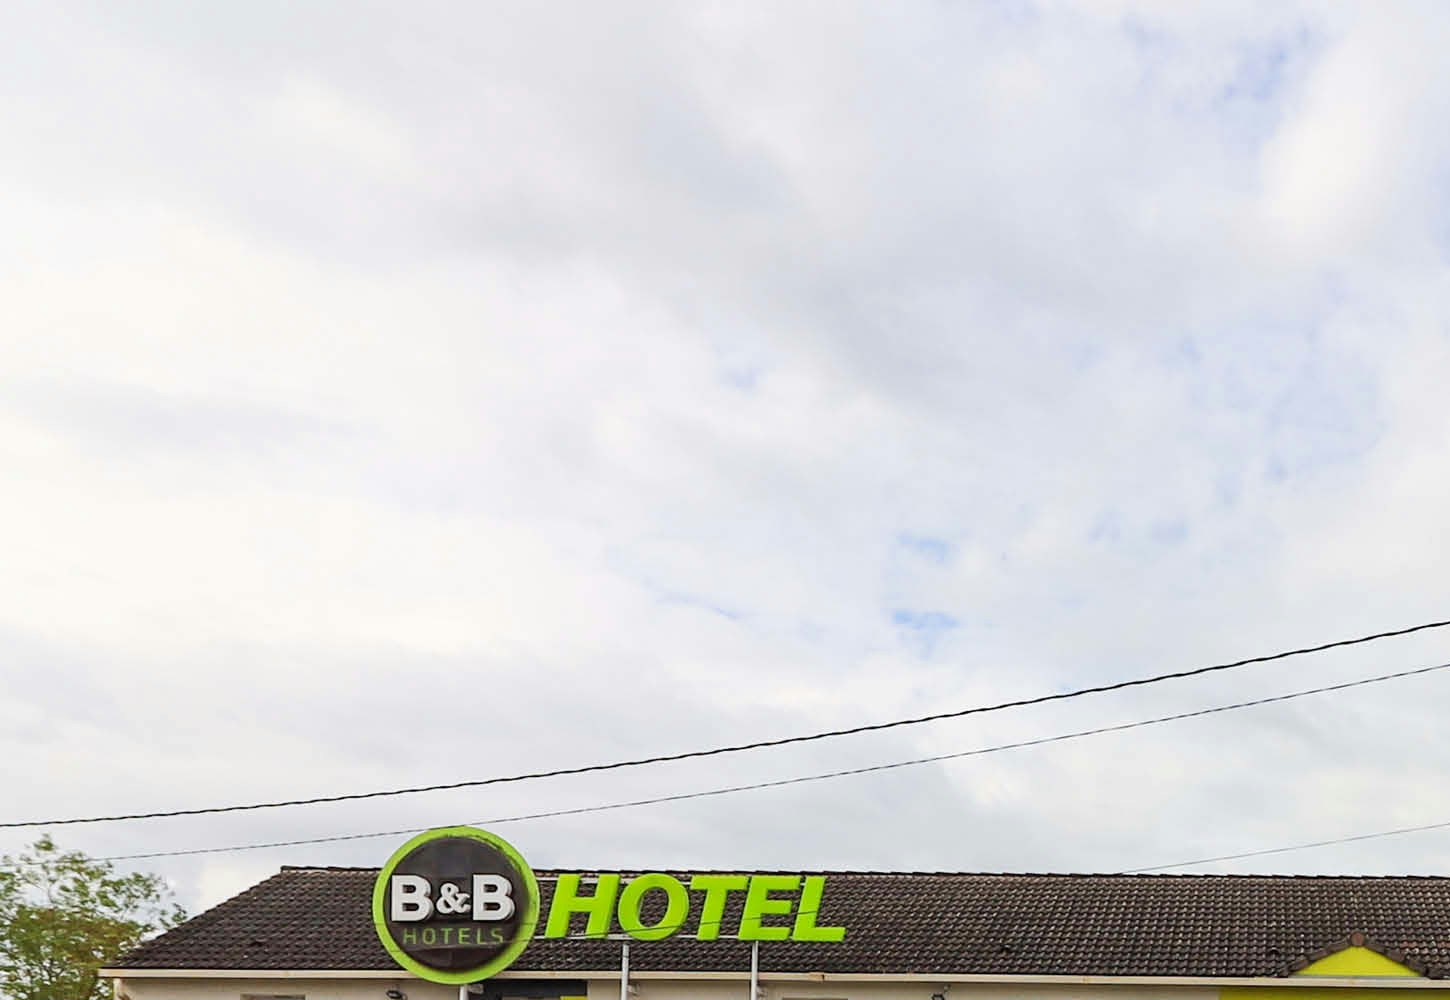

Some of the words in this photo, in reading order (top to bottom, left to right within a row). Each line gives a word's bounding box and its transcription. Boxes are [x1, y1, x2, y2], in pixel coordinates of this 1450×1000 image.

[391, 874, 515, 921] B&B
[544, 873, 847, 942] HOTEL
[402, 927, 504, 945] HOTELS
